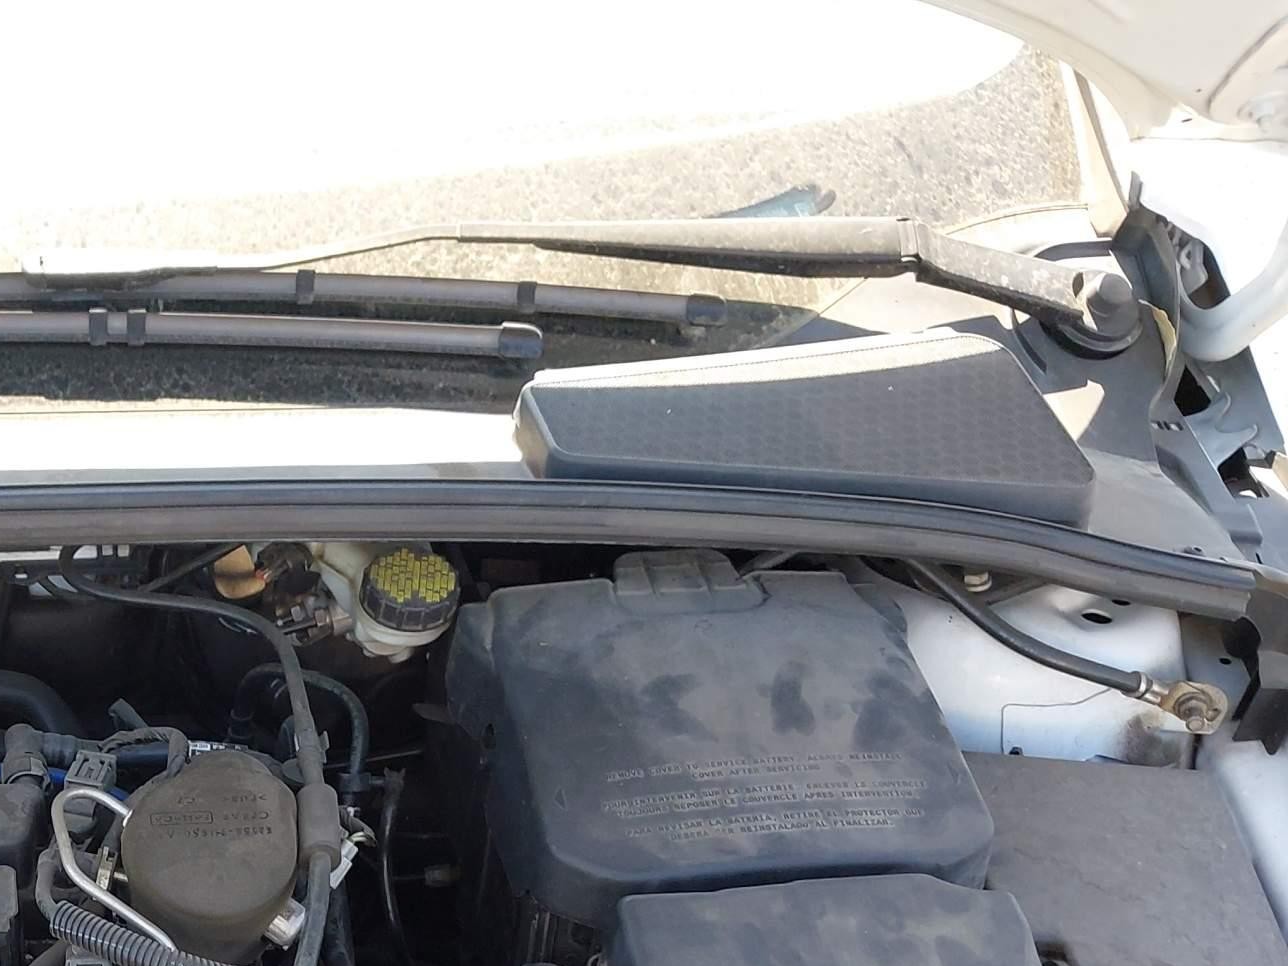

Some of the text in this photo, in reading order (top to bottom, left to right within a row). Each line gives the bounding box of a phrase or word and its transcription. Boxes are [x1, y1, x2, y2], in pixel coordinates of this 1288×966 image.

[692, 770, 724, 781] COVER
[729, 766, 759, 776] AFTER
[727, 787, 739, 796] LA
[708, 818, 722, 827] LA
[815, 819, 830, 829] AL
